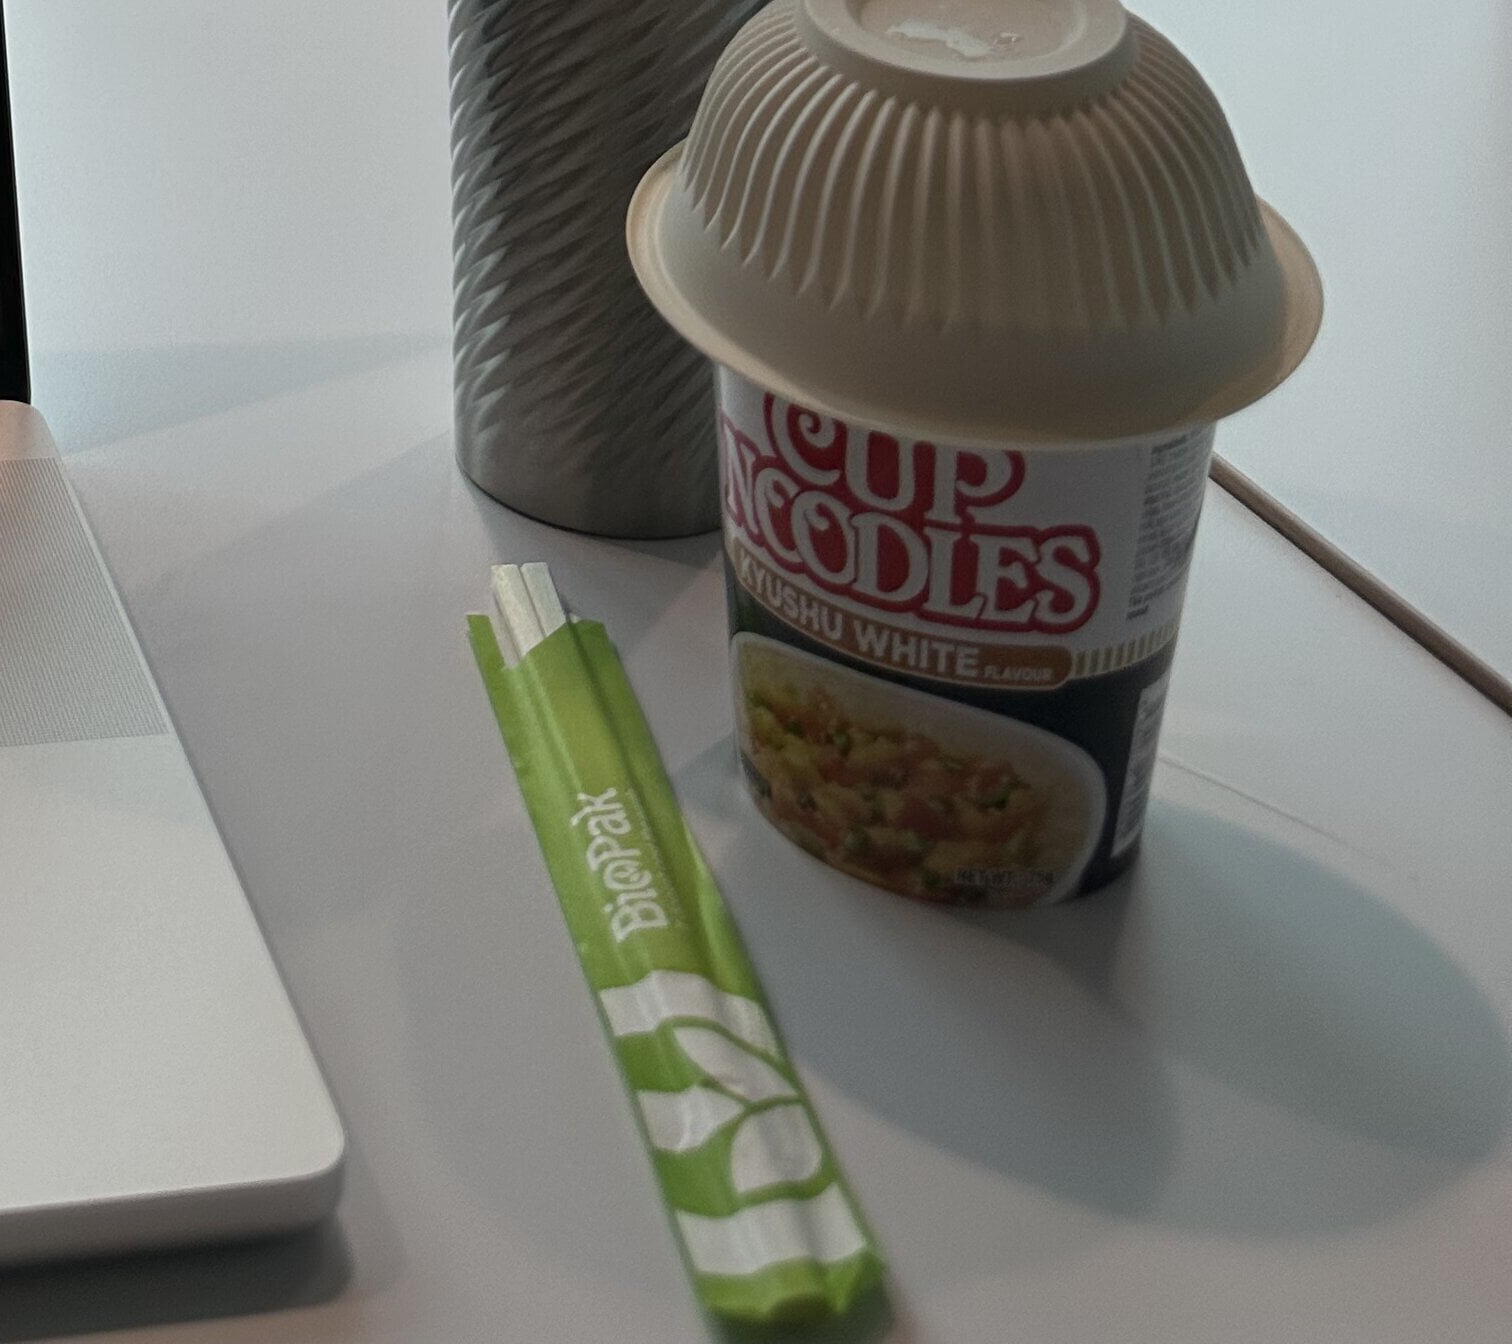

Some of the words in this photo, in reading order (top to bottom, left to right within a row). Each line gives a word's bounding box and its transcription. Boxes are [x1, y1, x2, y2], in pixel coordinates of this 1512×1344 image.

[722, 410, 1100, 633] NOODLES
[763, 395, 1026, 528] CUP
[737, 547, 845, 640] KYUSHU
[854, 622, 981, 678] WHITE
[984, 663, 1054, 682] FLAVOUR
[570, 787, 669, 943] BioPak
